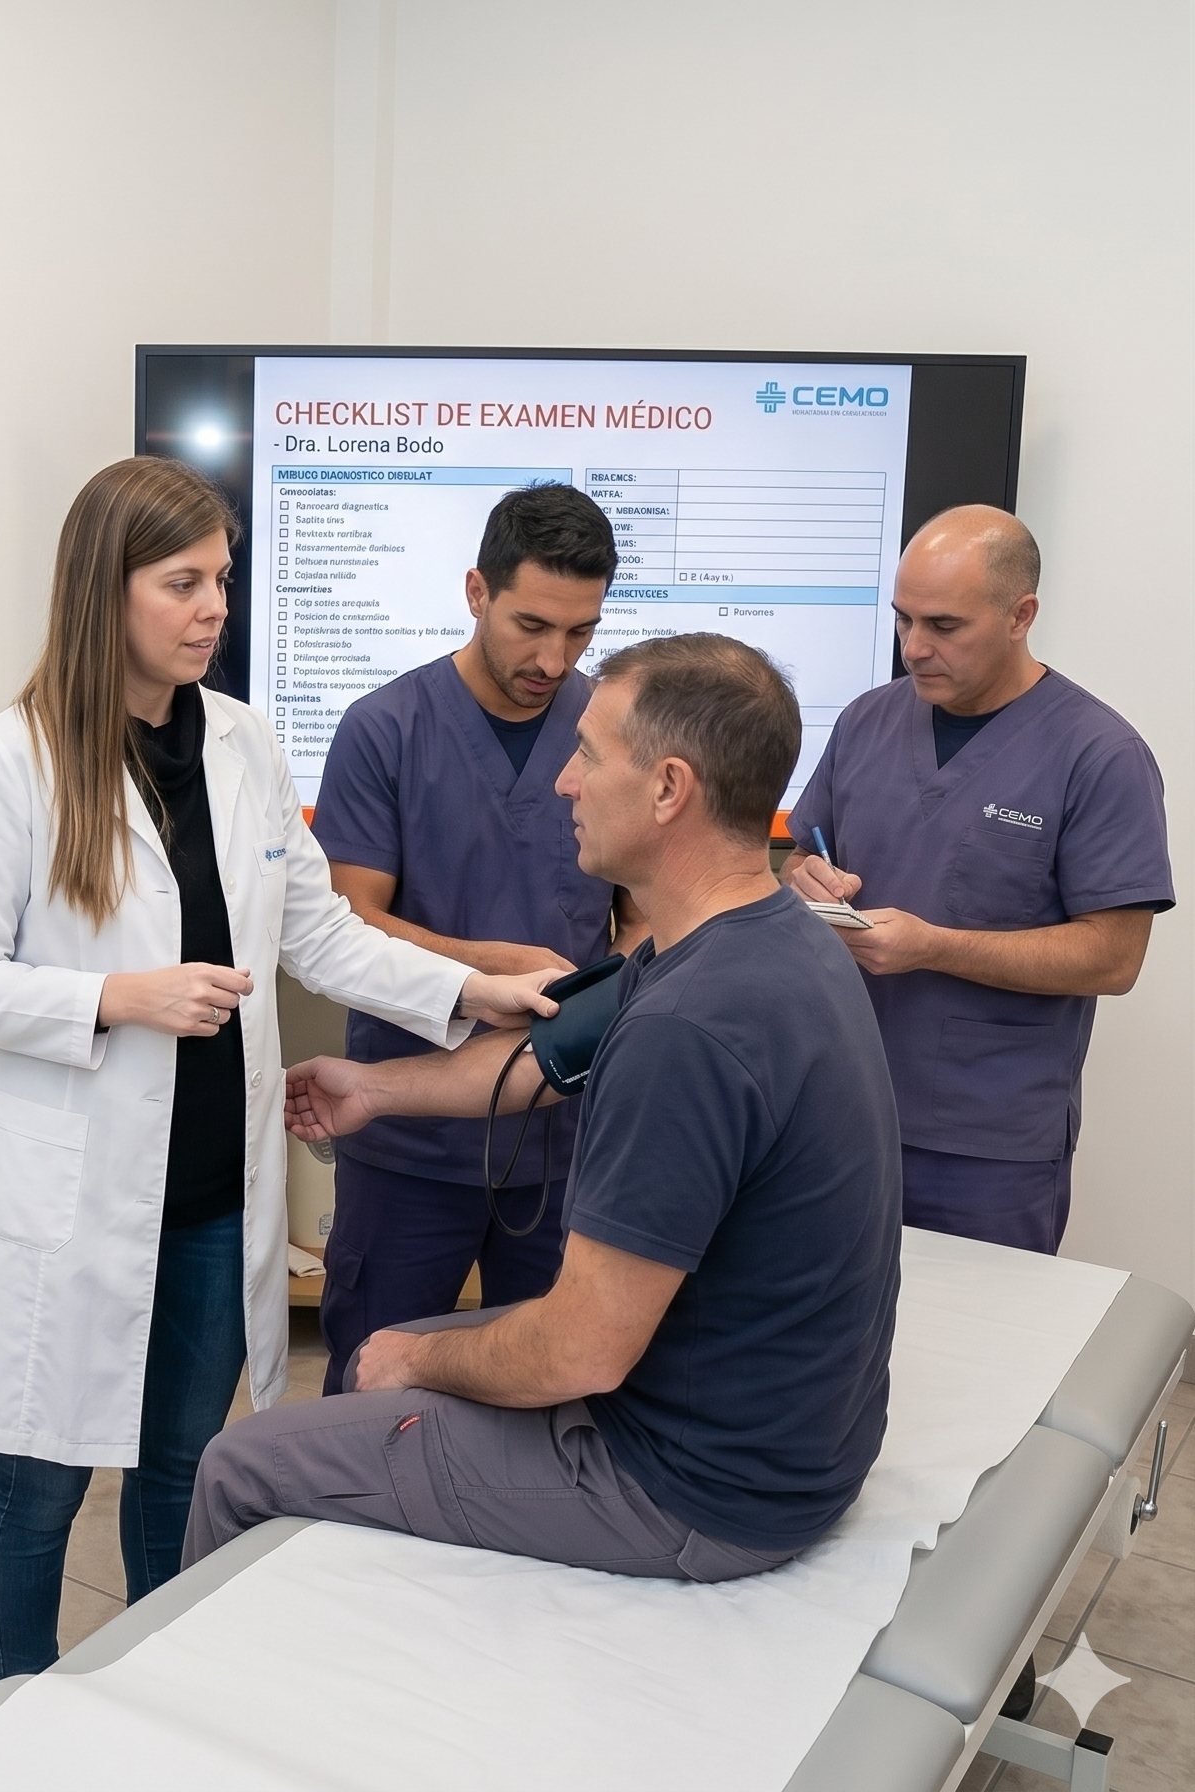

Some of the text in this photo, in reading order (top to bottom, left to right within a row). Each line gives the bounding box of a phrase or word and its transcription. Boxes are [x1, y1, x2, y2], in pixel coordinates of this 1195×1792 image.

[793, 387, 888, 406] CEMO
[275, 399, 711, 430] CHECKLIST DE EXAMEN MÉDICO
[285, 436, 320, 452] Dra.
[328, 436, 389, 453] Lorena
[397, 437, 444, 454] Bodo
[999, 808, 1043, 825] CEMO
